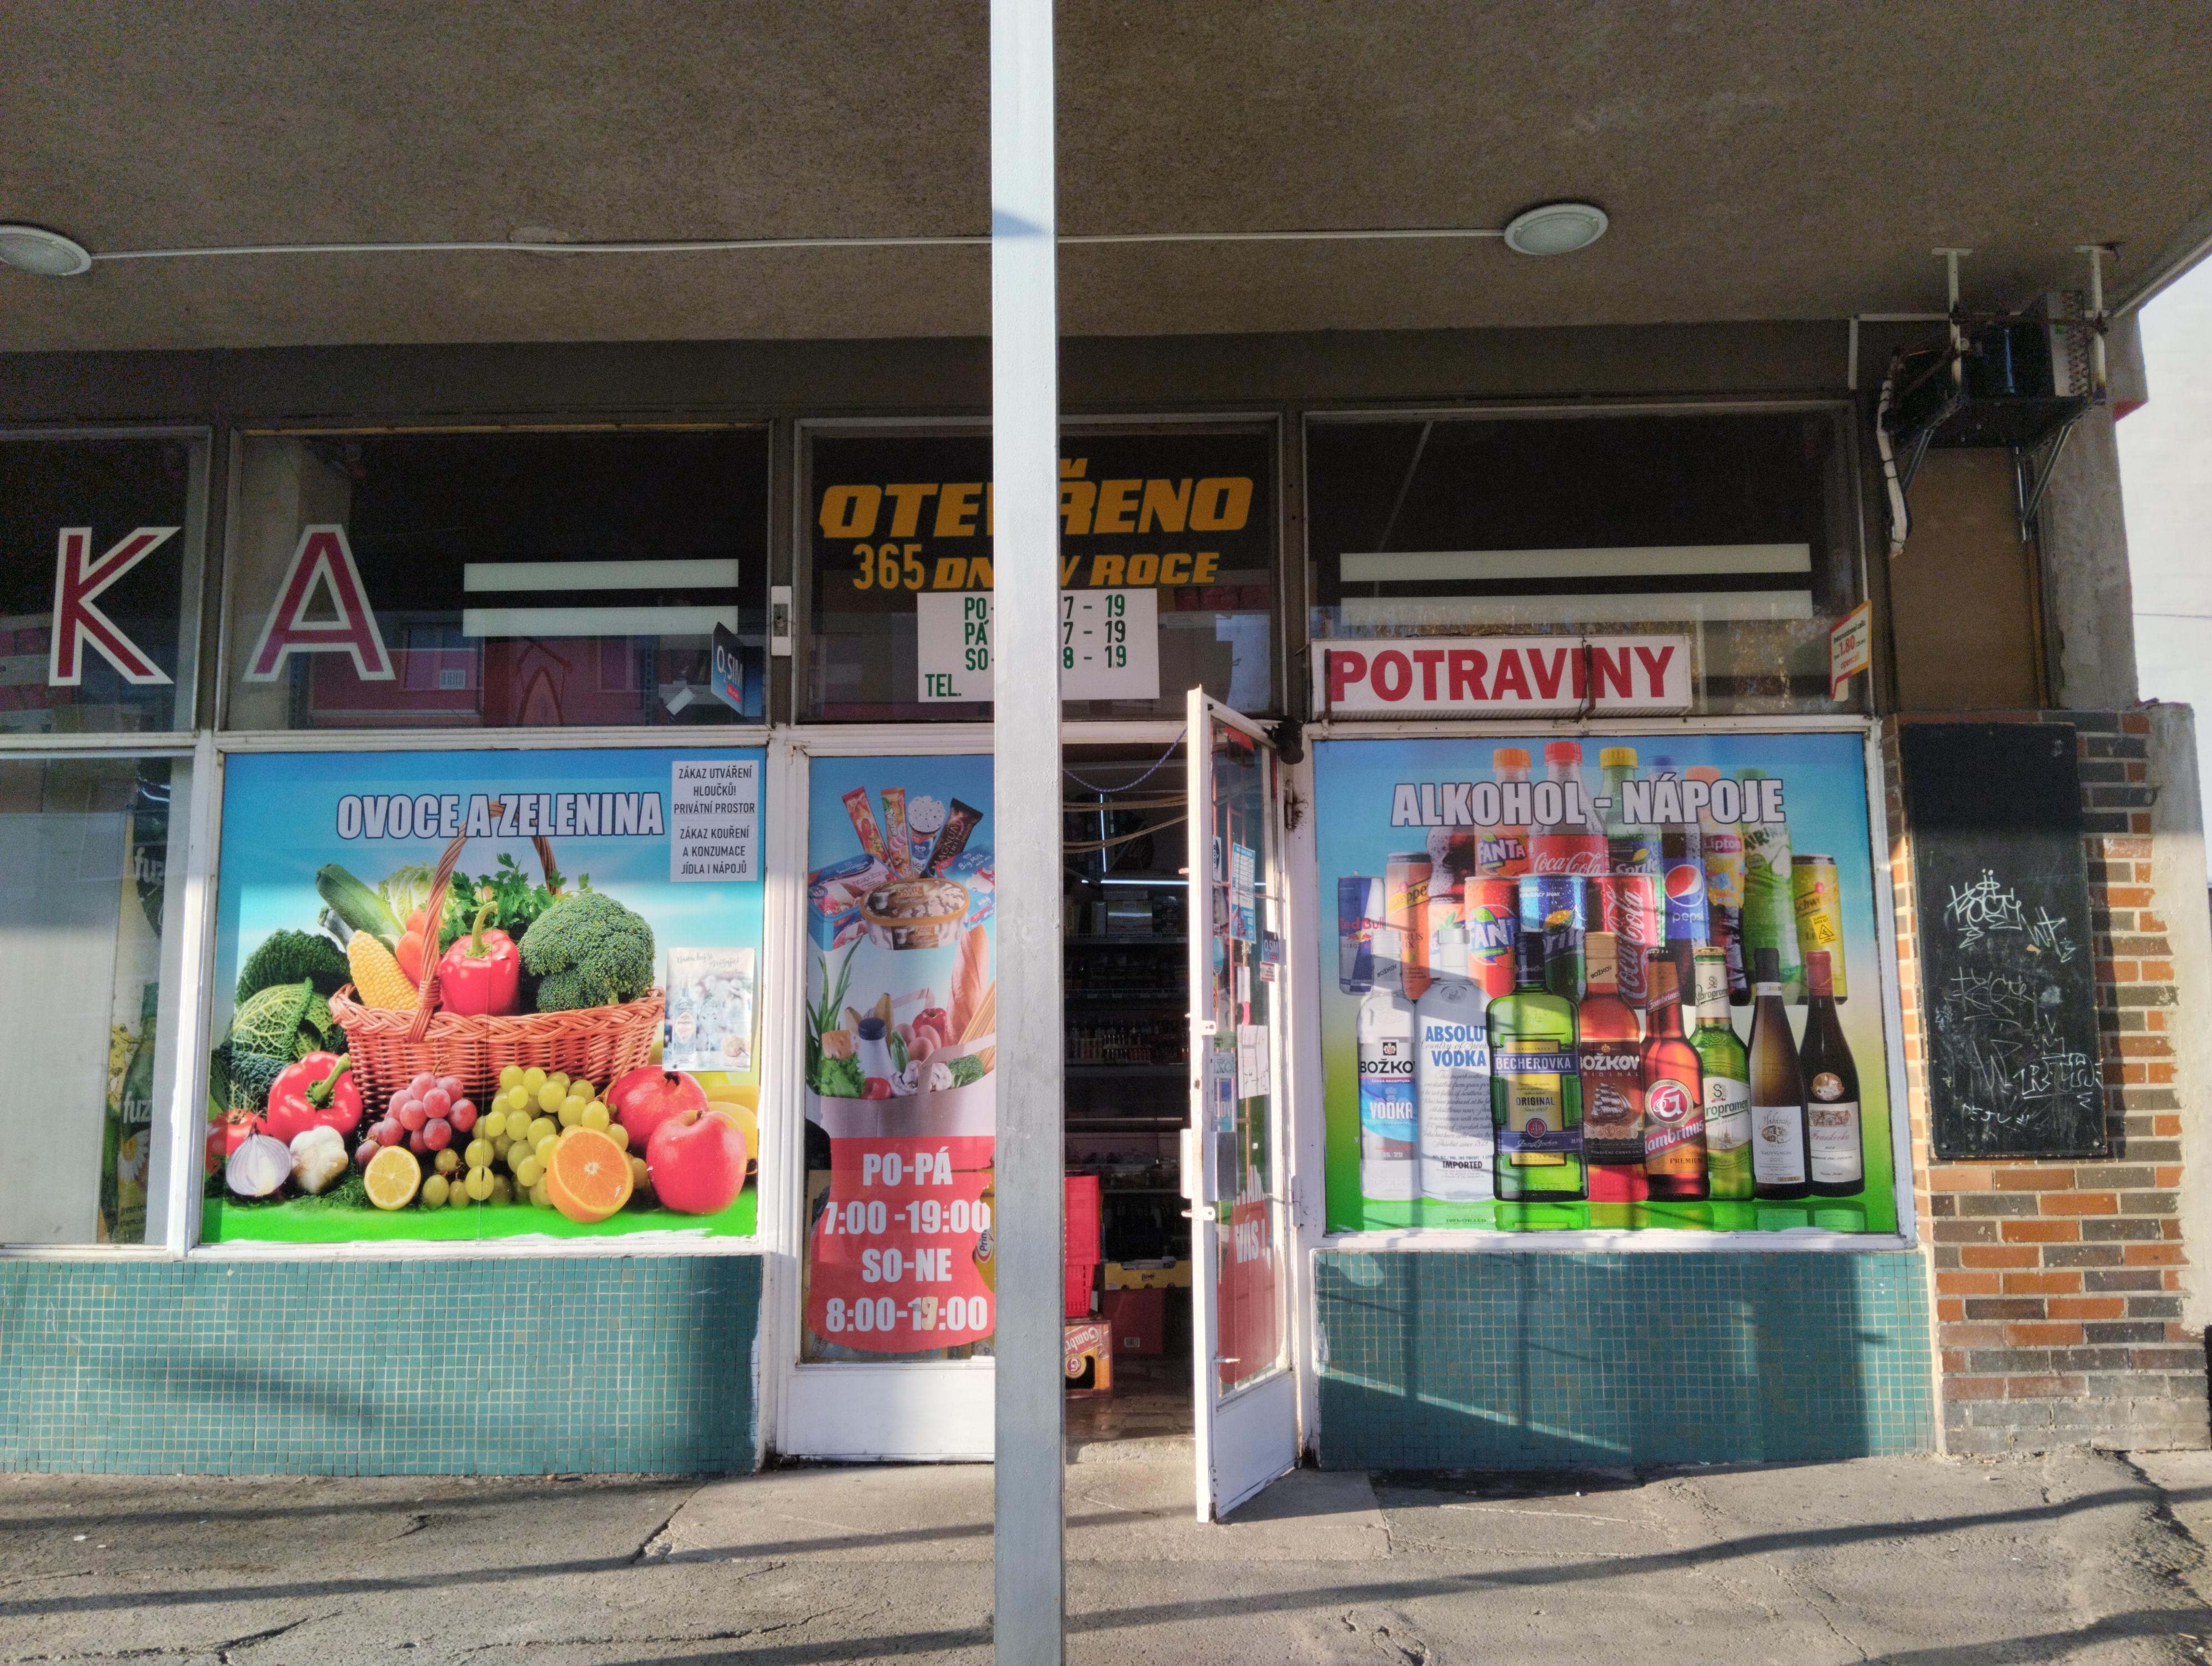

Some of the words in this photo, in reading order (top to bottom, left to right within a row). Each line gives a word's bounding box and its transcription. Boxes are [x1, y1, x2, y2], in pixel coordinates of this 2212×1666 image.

[818, 458, 1254, 538] OTEŘENO
[853, 544, 924, 590] 365
[932, 557, 994, 589] DN
[1089, 553, 1220, 586] ROCE
[1063, 596, 1074, 619] 7
[1105, 594, 1125, 618] 19
[964, 619, 989, 645] PÁ
[1063, 622, 1074, 645] 7
[1105, 620, 1125, 643] 19
[1839, 634, 1856, 656] 1.80
[1063, 646, 1074, 669] 8
[1105, 645, 1127, 668] 19
[727, 653, 743, 689] SIM
[1330, 645, 1676, 702] POTRAVINY
[924, 674, 962, 697] TEL.
[678, 766, 707, 779] ZÁKAZ
[710, 765, 753, 779] UTVÁŘENÍ
[693, 782, 736, 796] HLOUČKŮ!
[674, 801, 713, 814] PRIVÁTNÍ
[715, 802, 755, 814] PROSTOR
[1390, 780, 1586, 827] ALKOHOL
[1622, 772, 1786, 825] NÁPOJE
[336, 794, 460, 839] OVOCE
[463, 794, 492, 838] A
[497, 791, 665, 837] ZELENINA
[680, 826, 708, 839] ZÁKAZ
[711, 825, 750, 839] KOUŘENÍ
[682, 846, 688, 857] A
[692, 846, 746, 857] KONZUMACE
[1477, 839, 1526, 863] FANTA
[1702, 837, 1742, 850] Lipton
[681, 861, 705, 874] JÍDLA
[707, 864, 710, 874] I
[712, 860, 747, 874] NÁPOJŮ
[958, 860, 973, 870] Big
[970, 852, 985, 863] Milk
[1362, 916, 1385, 930] Bull
[1672, 911, 1704, 923] pepsi
[1425, 1025, 1487, 1042] ABSOLU
[1360, 1058, 1415, 1074] BOŽKO
[1431, 1050, 1487, 1067] VODKA
[1496, 1057, 1571, 1070] BECHEROVKA
[1369, 1101, 1413, 1120] VODKA
[1516, 1096, 1555, 1106] ORIGINAL
[1706, 1098, 1748, 1117] ropramen
[862, 1146, 953, 1186] PO-PÁ
[1442, 1161, 1482, 1169] IMPORTED
[825, 1200, 887, 1235] 7:00
[862, 1248, 952, 1283] SO-NE
